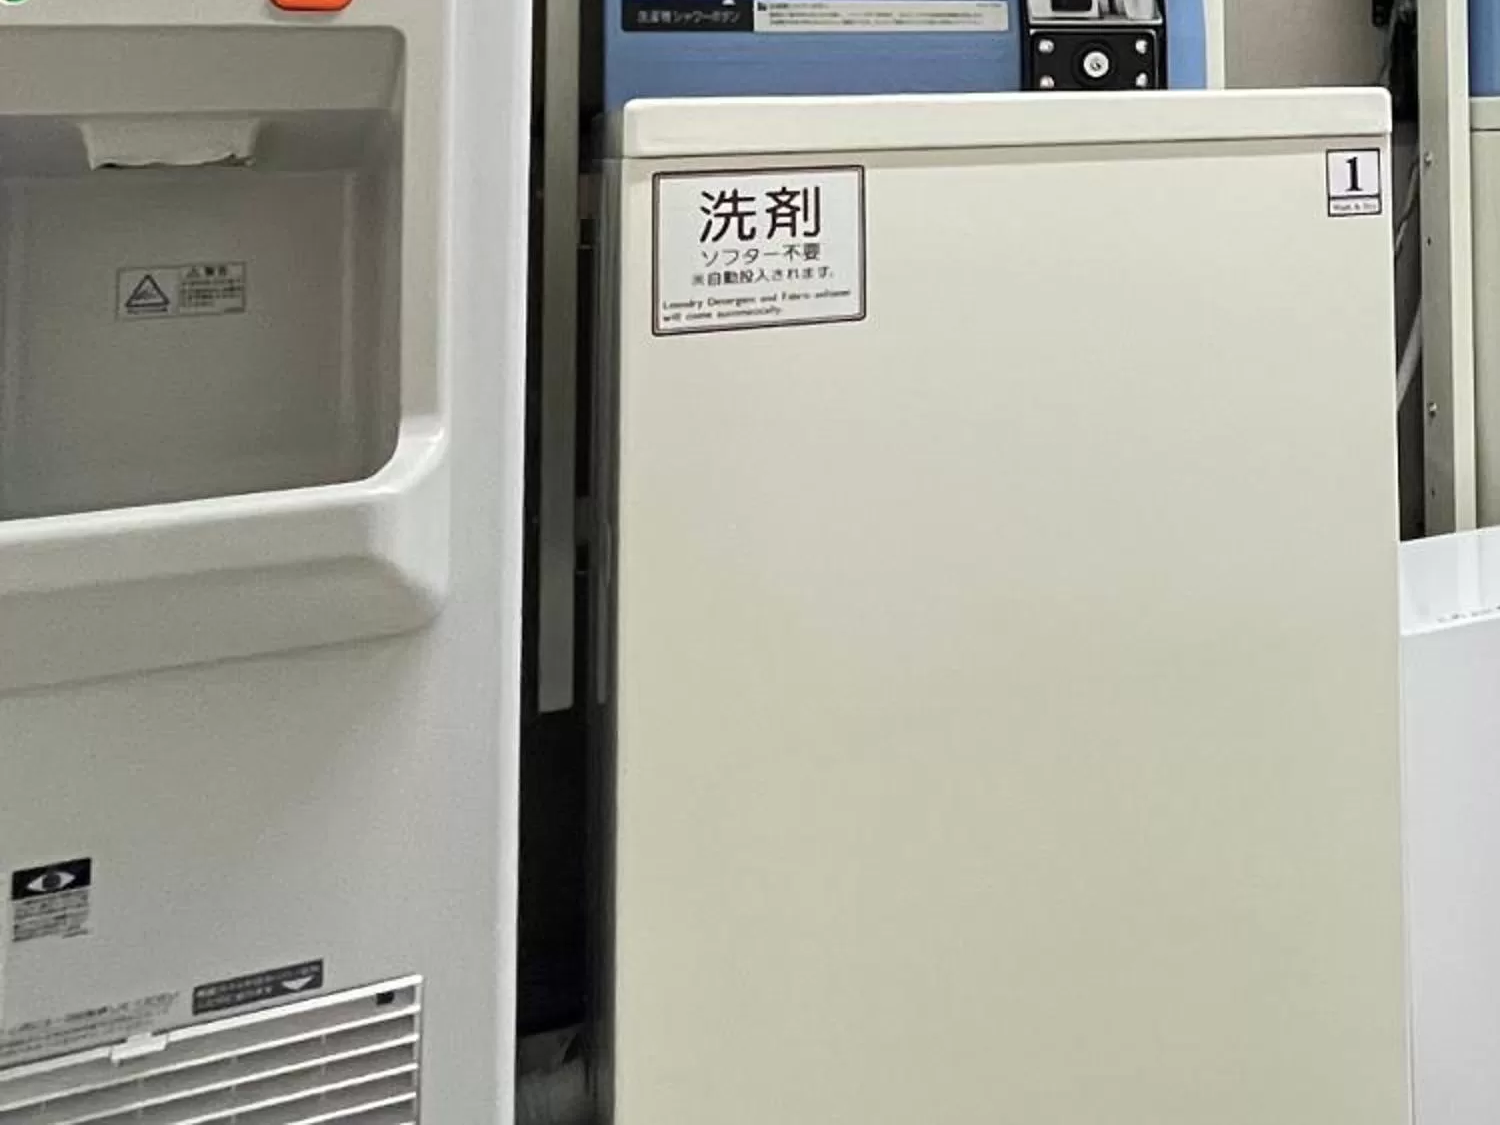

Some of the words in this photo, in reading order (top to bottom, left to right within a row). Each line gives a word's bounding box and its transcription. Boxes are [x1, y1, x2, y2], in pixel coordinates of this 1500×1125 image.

[1345, 156, 1364, 192] 1
[699, 185, 822, 244] 洗剤
[701, 243, 823, 268] ソフター不要
